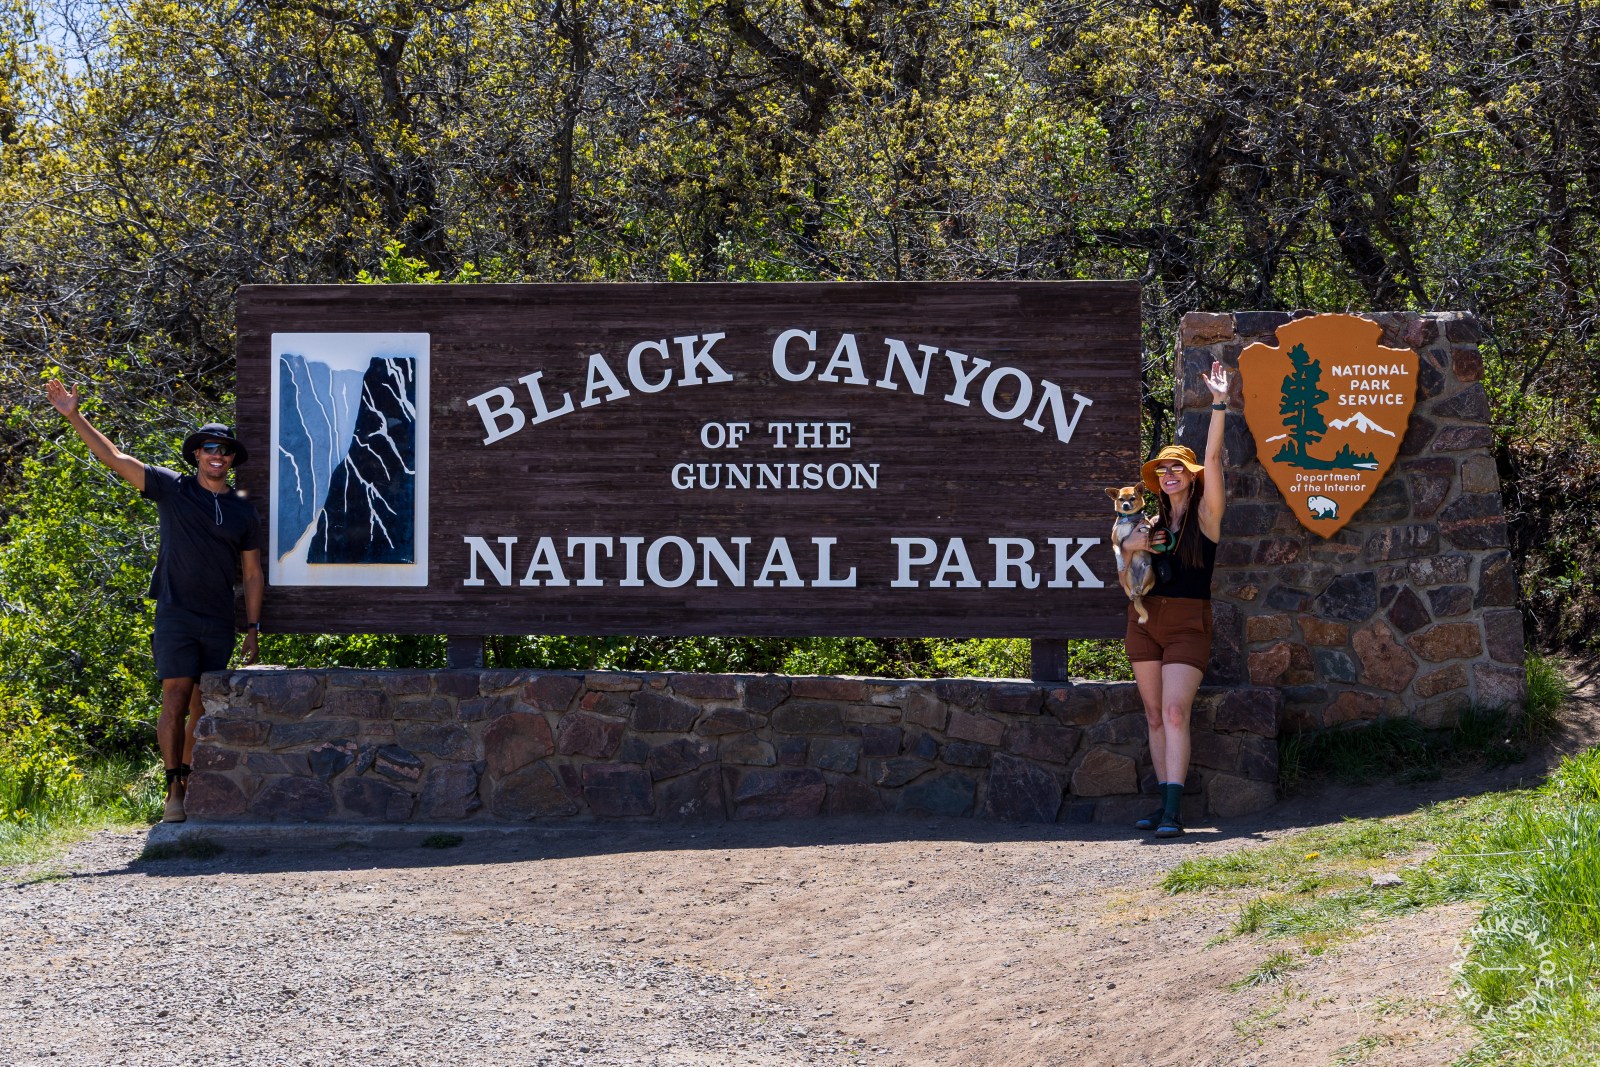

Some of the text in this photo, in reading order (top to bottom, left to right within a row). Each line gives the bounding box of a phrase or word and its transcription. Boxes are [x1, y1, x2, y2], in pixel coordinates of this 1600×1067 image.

[1331, 363, 1409, 377] NATIONAL
[467, 329, 1093, 445] BLACK CANYON
[1350, 379, 1391, 391] PARK
[1337, 393, 1404, 406] SERVICE
[701, 423, 850, 448] OF THE
[672, 463, 879, 489] GUNNISON
[1295, 472, 1361, 484] Department
[1289, 482, 1367, 493] of the Interior
[464, 536, 1104, 588] NATIONAL PARK
